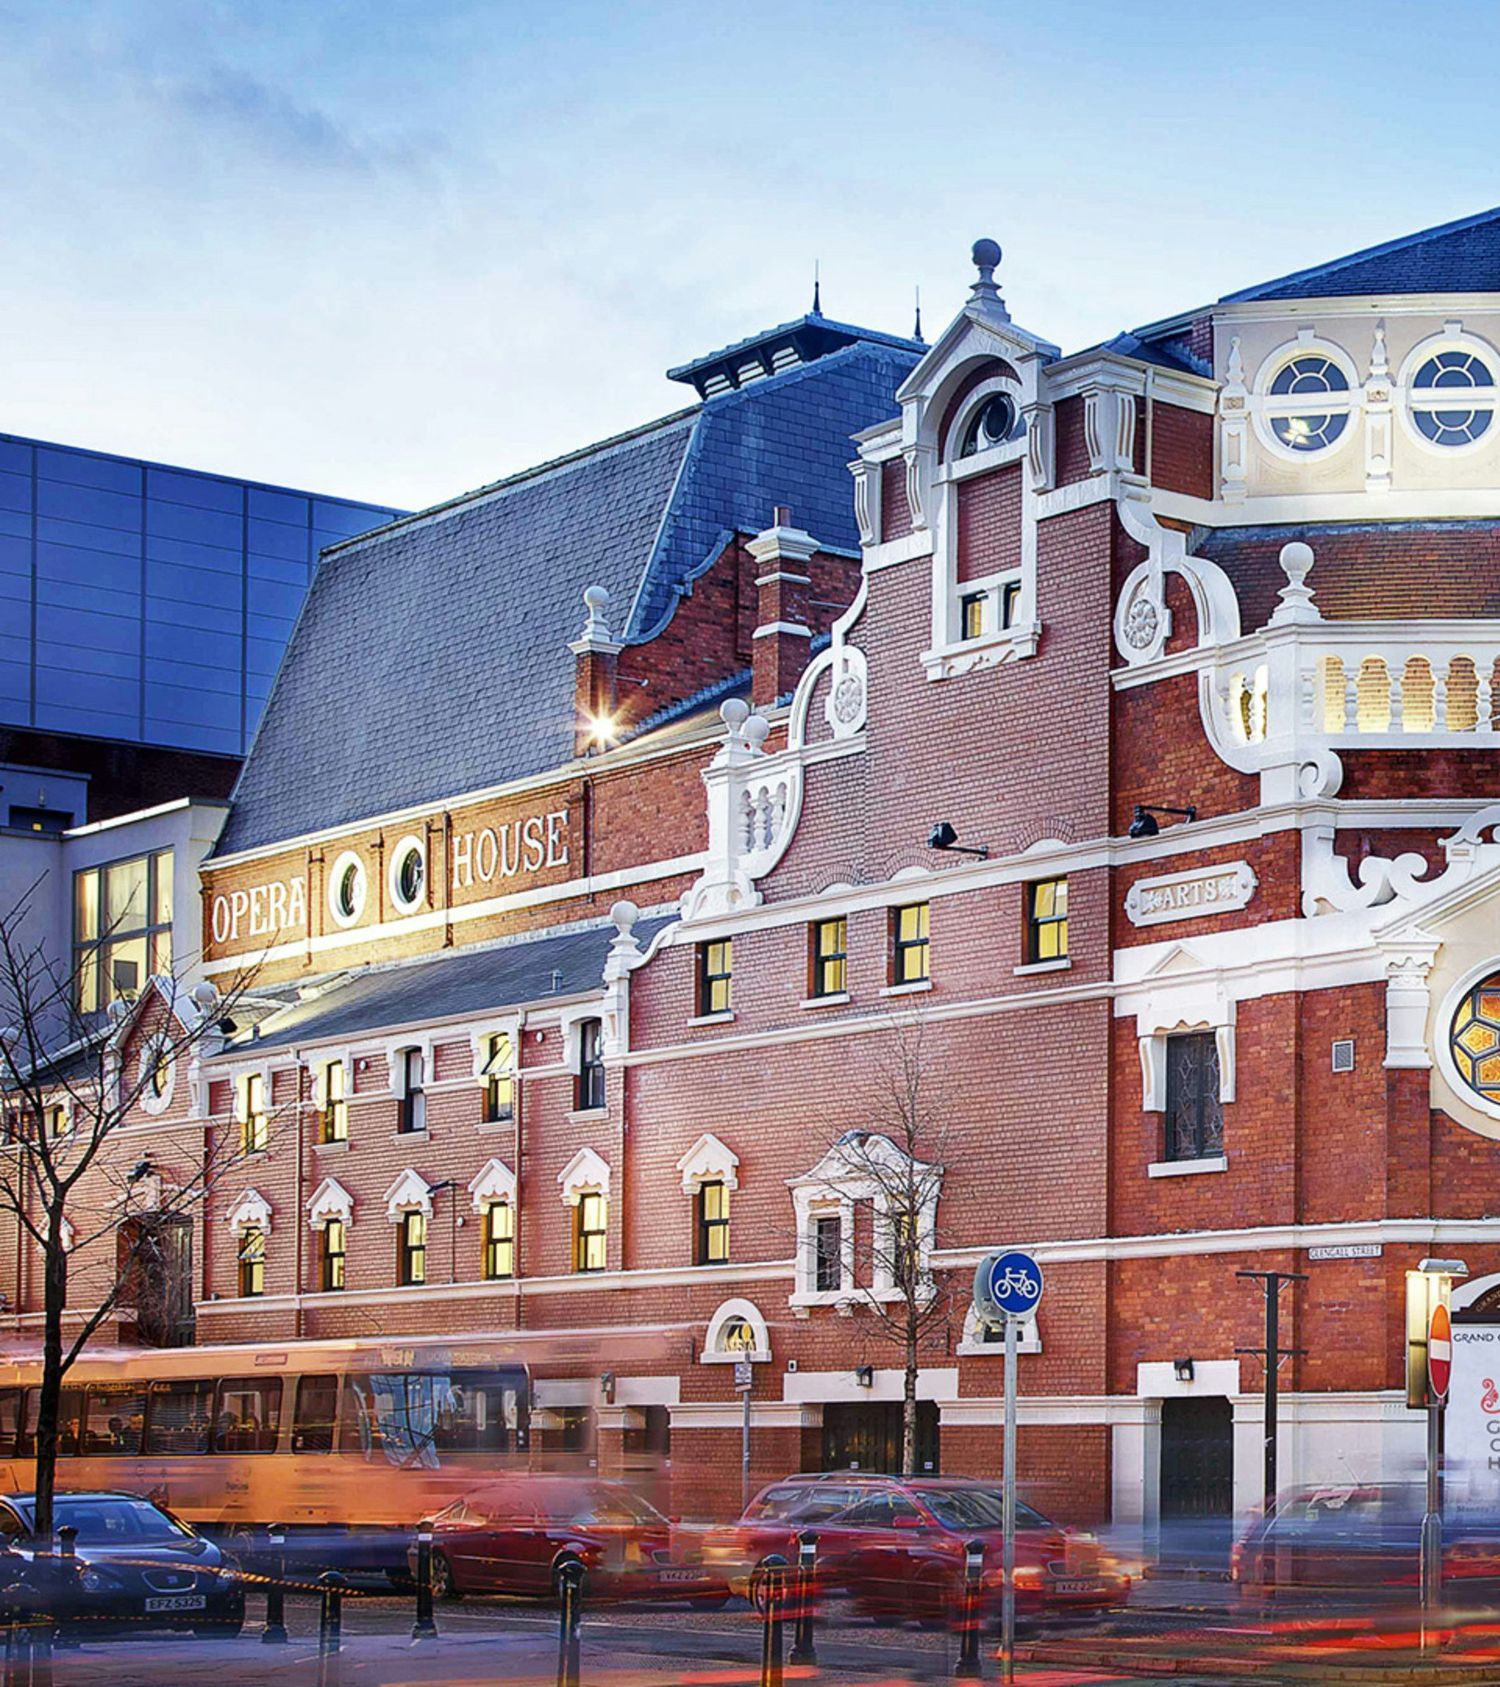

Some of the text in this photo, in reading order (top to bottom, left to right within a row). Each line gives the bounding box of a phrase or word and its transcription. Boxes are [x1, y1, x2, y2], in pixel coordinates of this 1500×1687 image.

[212, 810, 570, 943] OPERA HOUSE
[1162, 880, 1218, 911] ARTS
[1310, 1245, 1380, 1258] GLENGALL STREET
[1453, 1333, 1494, 1344] GRAND
